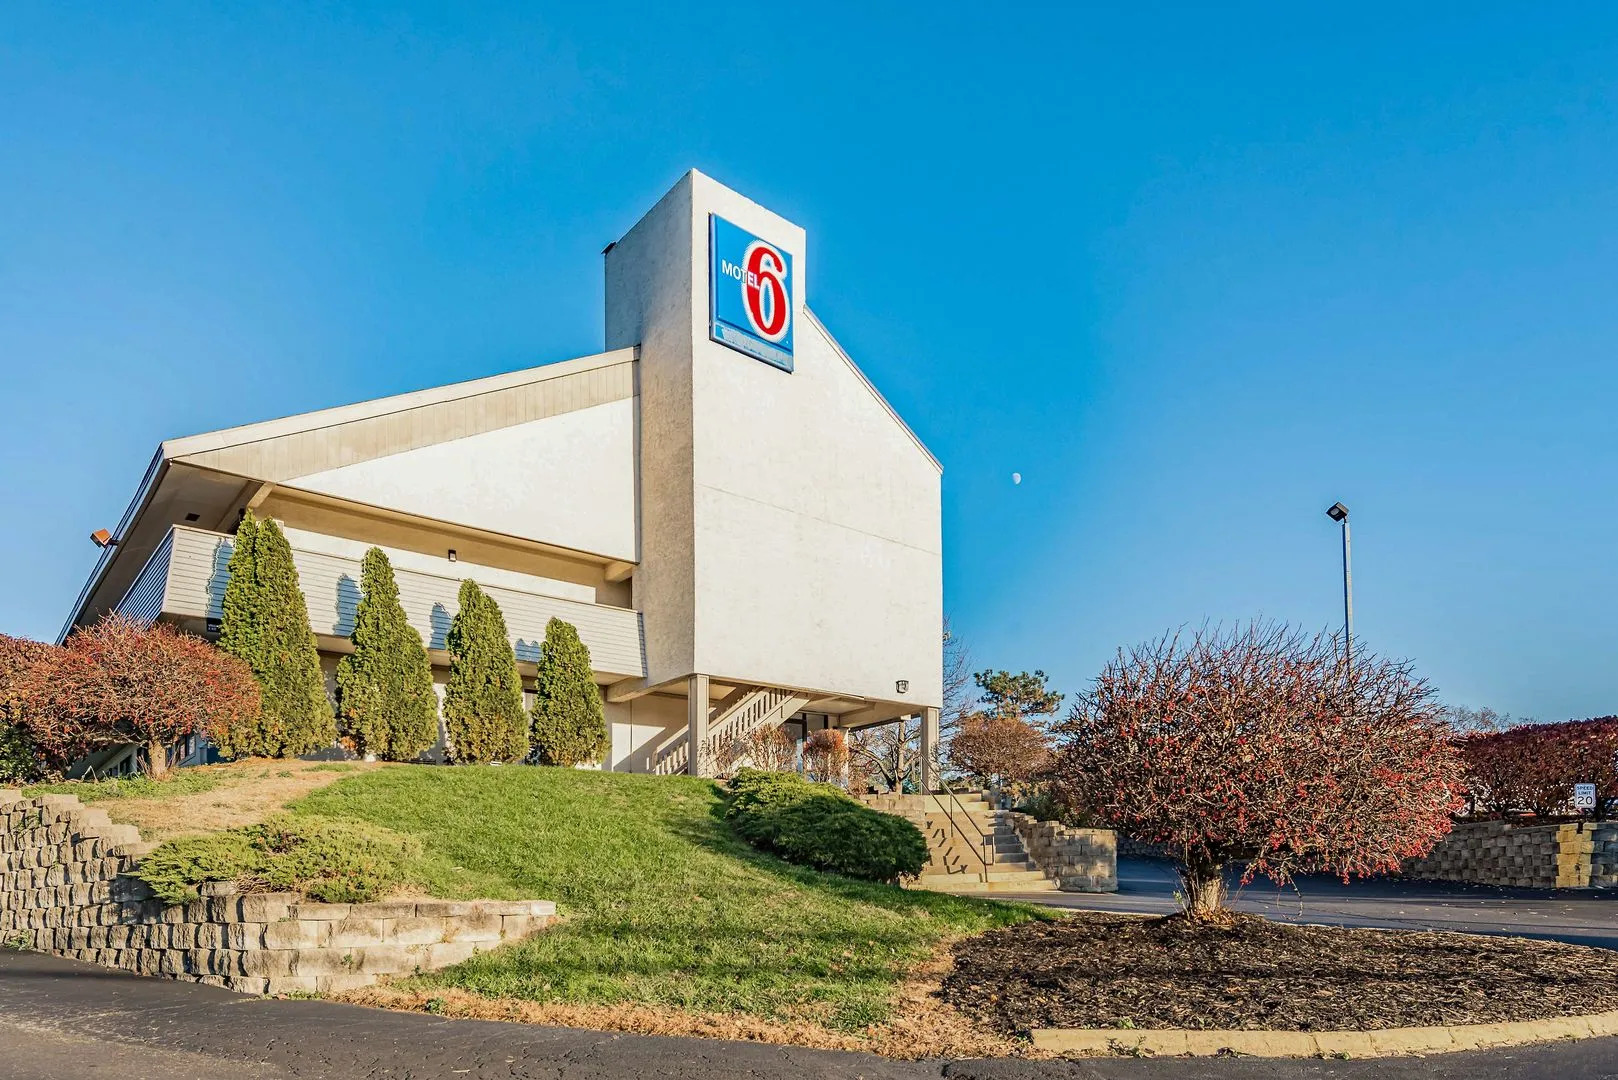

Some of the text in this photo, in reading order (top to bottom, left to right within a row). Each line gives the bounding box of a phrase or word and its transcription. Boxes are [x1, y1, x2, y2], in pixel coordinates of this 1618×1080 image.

[722, 244, 788, 339] MOTEL 6
[1577, 796, 1593, 805] 20
